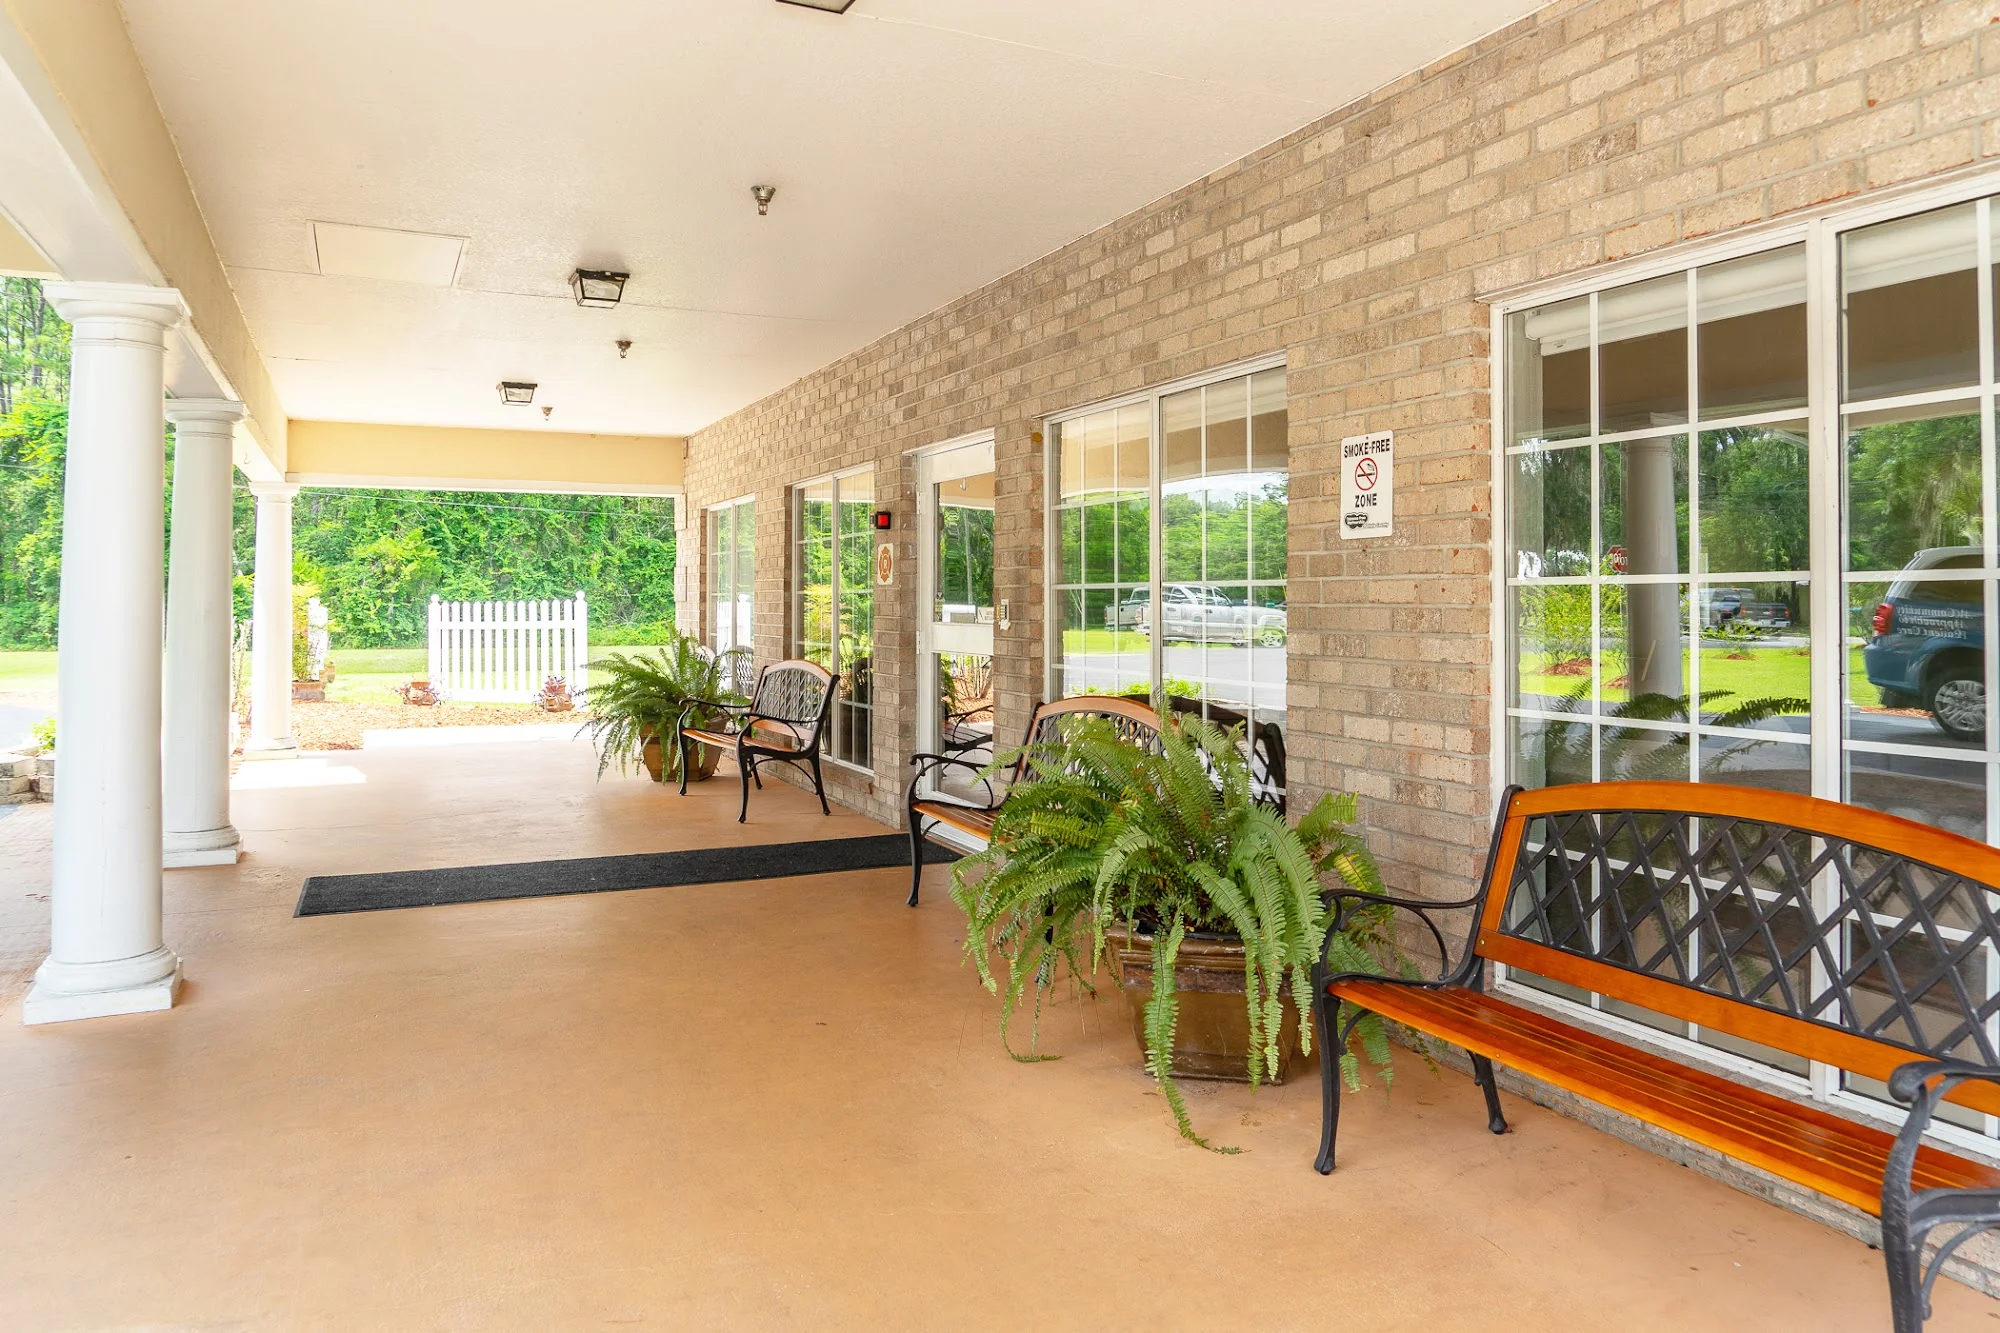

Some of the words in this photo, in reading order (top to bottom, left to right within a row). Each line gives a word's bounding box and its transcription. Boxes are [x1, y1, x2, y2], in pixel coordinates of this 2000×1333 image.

[1344, 438, 1390, 458] SMOKE-FREE
[1355, 493, 1377, 508] ZONE
[883, 559, 888, 569] R
